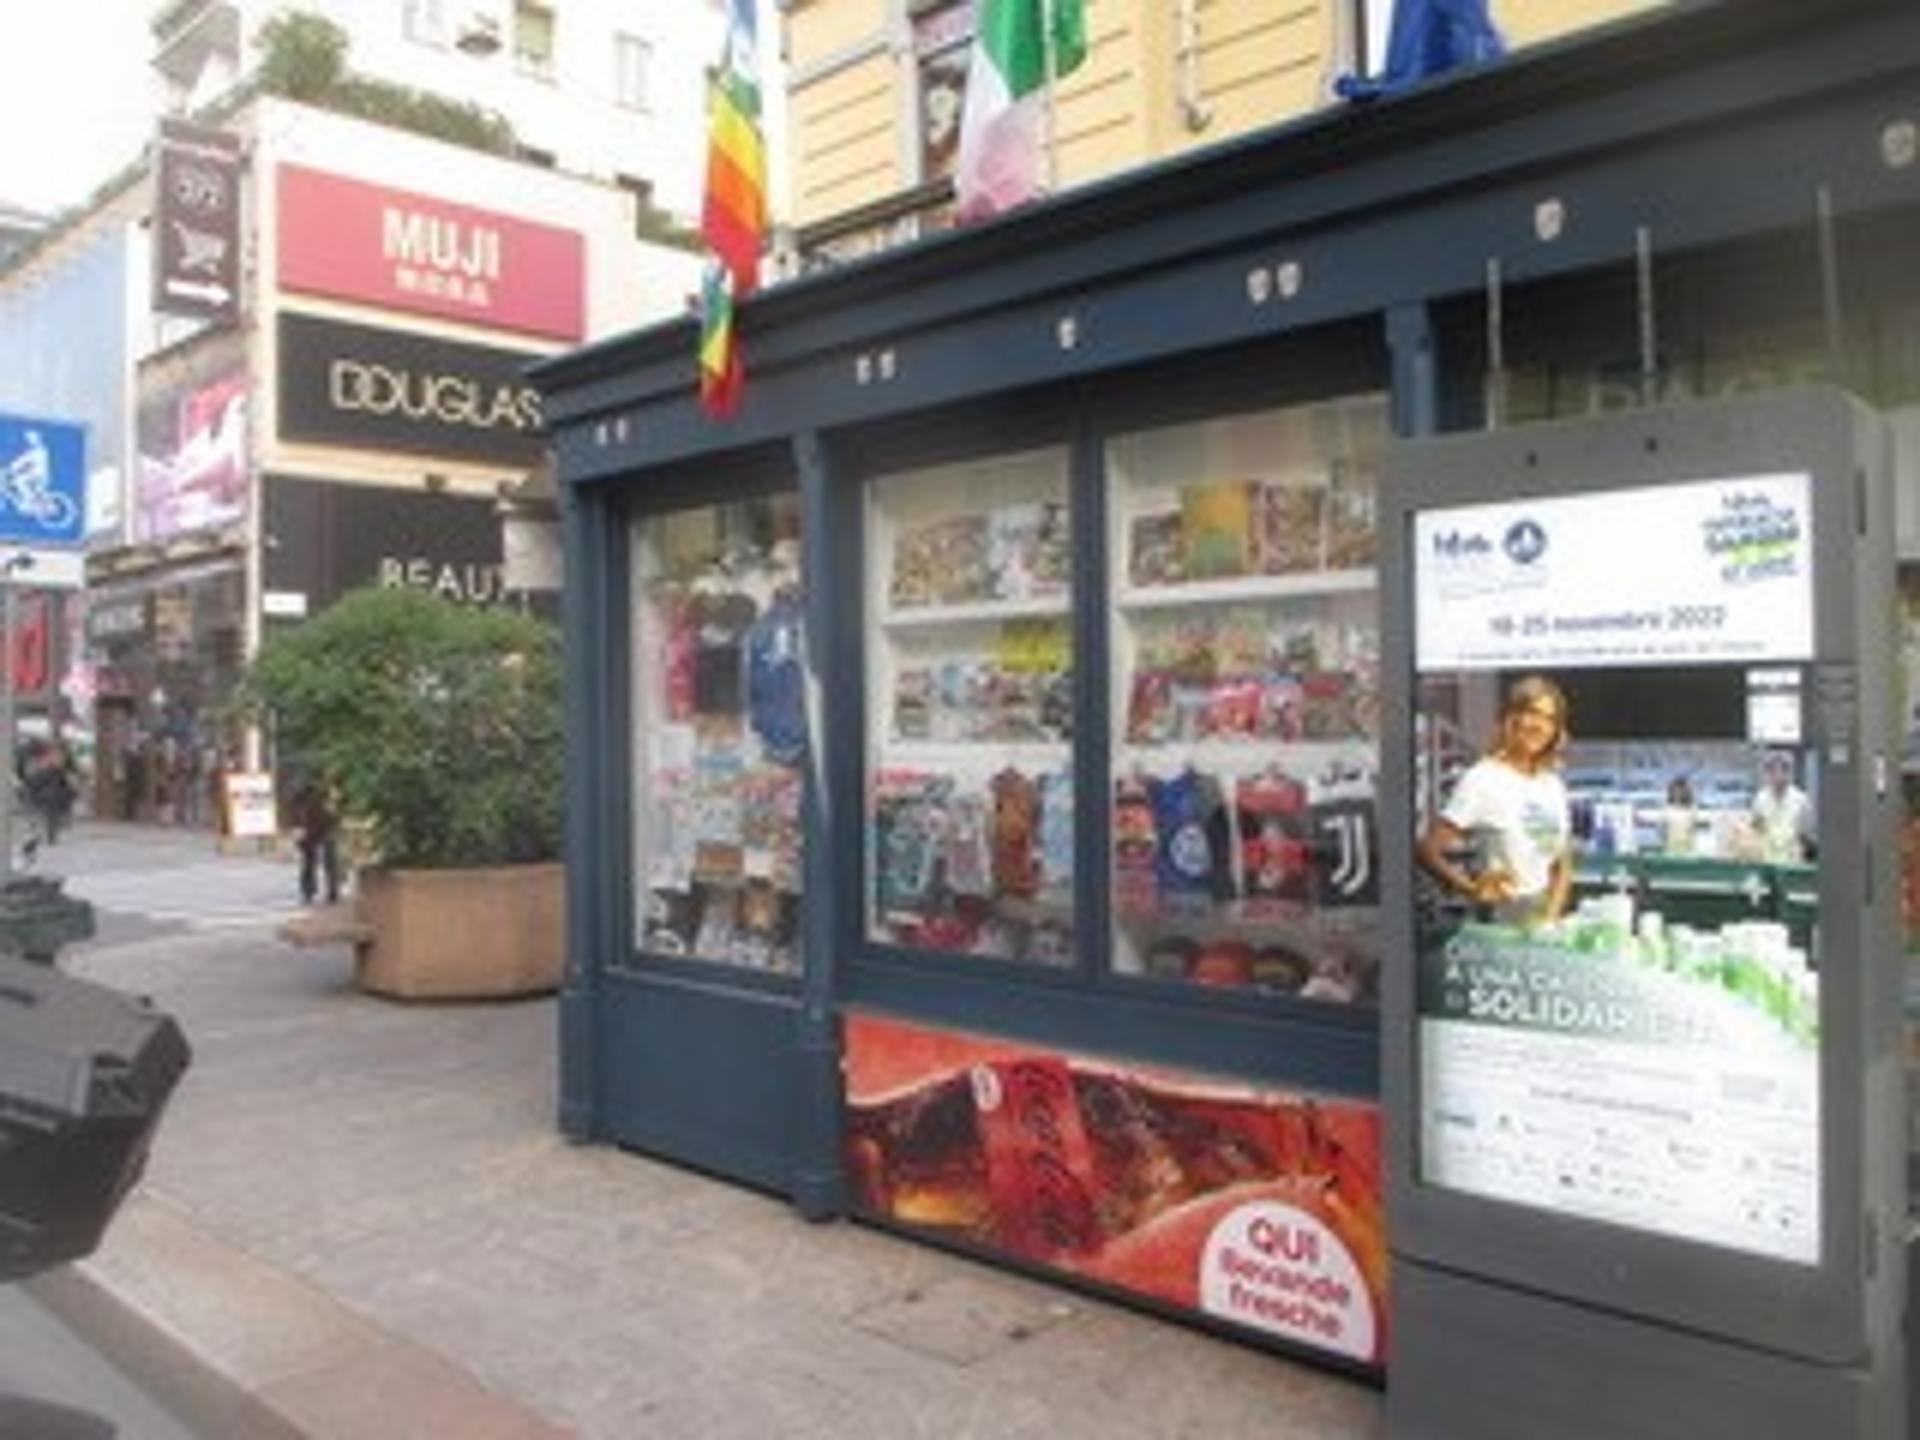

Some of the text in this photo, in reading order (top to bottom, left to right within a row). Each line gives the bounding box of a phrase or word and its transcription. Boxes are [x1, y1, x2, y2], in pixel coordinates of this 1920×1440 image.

[383, 207, 499, 279] MUJI
[330, 360, 542, 428] DOUGLAS
[381, 557, 531, 611] BEAU
[1249, 1217, 1319, 1265] QUI
